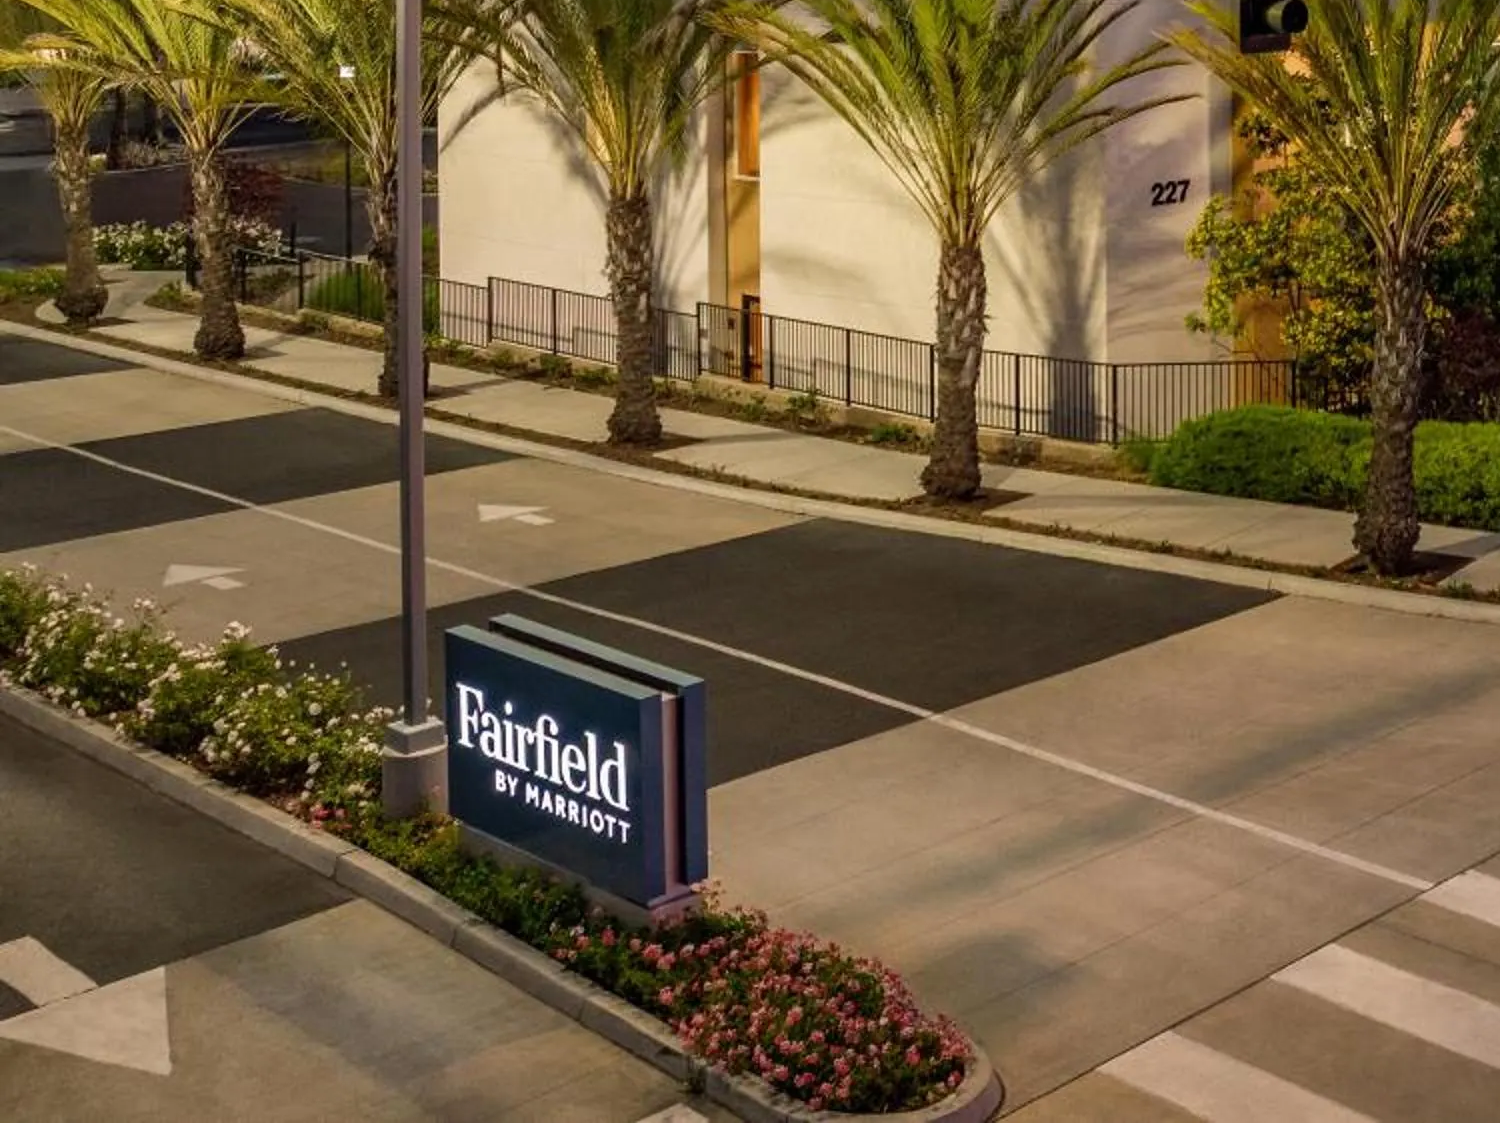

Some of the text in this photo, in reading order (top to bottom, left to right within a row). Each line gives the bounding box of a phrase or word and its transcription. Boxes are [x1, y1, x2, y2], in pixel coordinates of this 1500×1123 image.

[1151, 179, 1190, 207] 227
[456, 681, 630, 812] Fairfield
[495, 769, 631, 844] BY MARRIOTT
